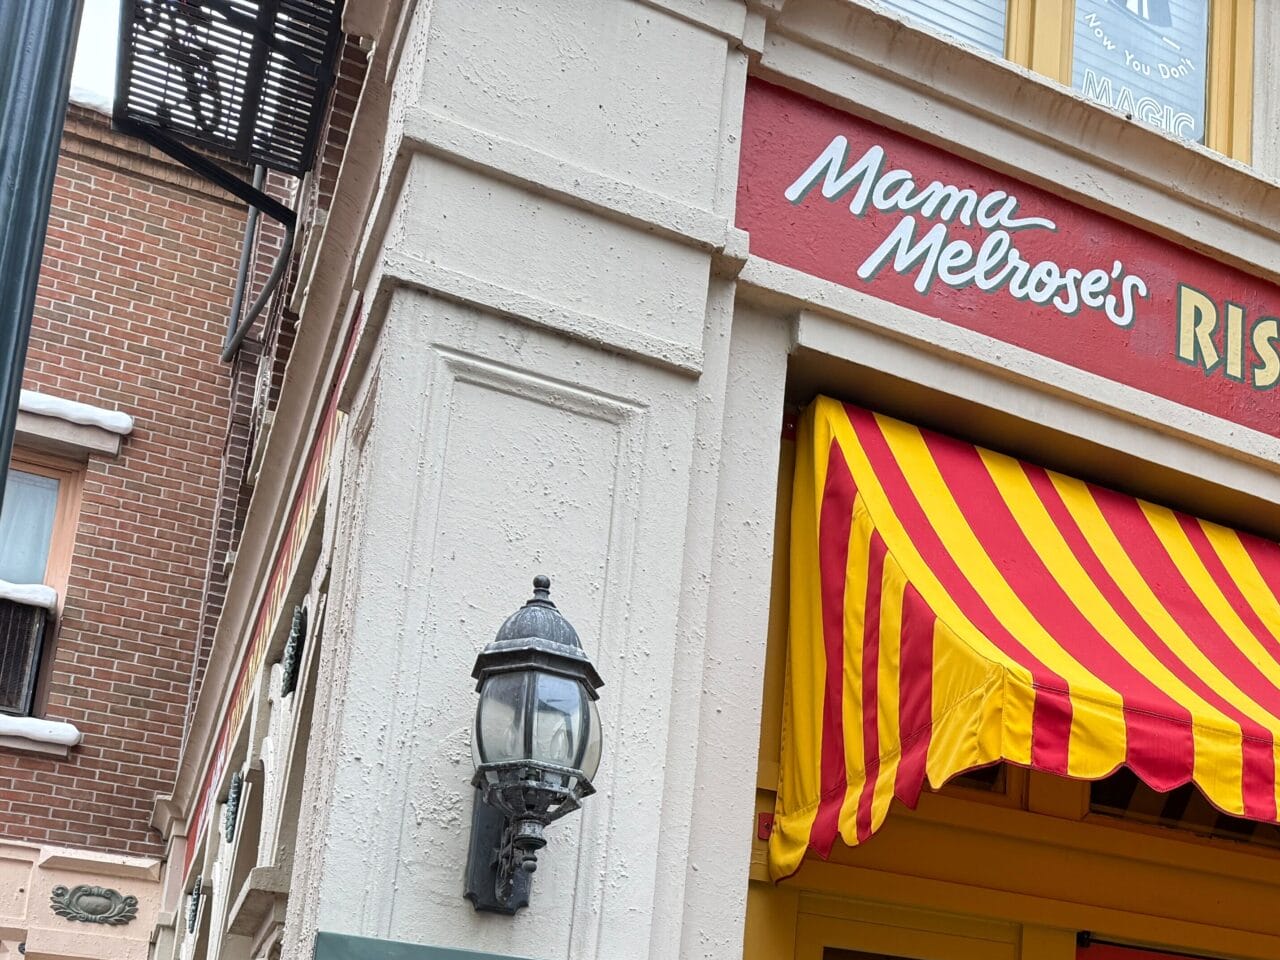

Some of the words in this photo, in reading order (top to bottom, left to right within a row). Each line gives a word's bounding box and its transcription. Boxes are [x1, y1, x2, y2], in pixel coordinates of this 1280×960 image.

[1085, 12, 1116, 51] Now
[1124, 49, 1151, 76] You
[1157, 57, 1196, 79] Don't
[1082, 68, 1195, 140] MAGIC
[784, 135, 1057, 230] Mama
[857, 215, 1148, 327] Melrose's
